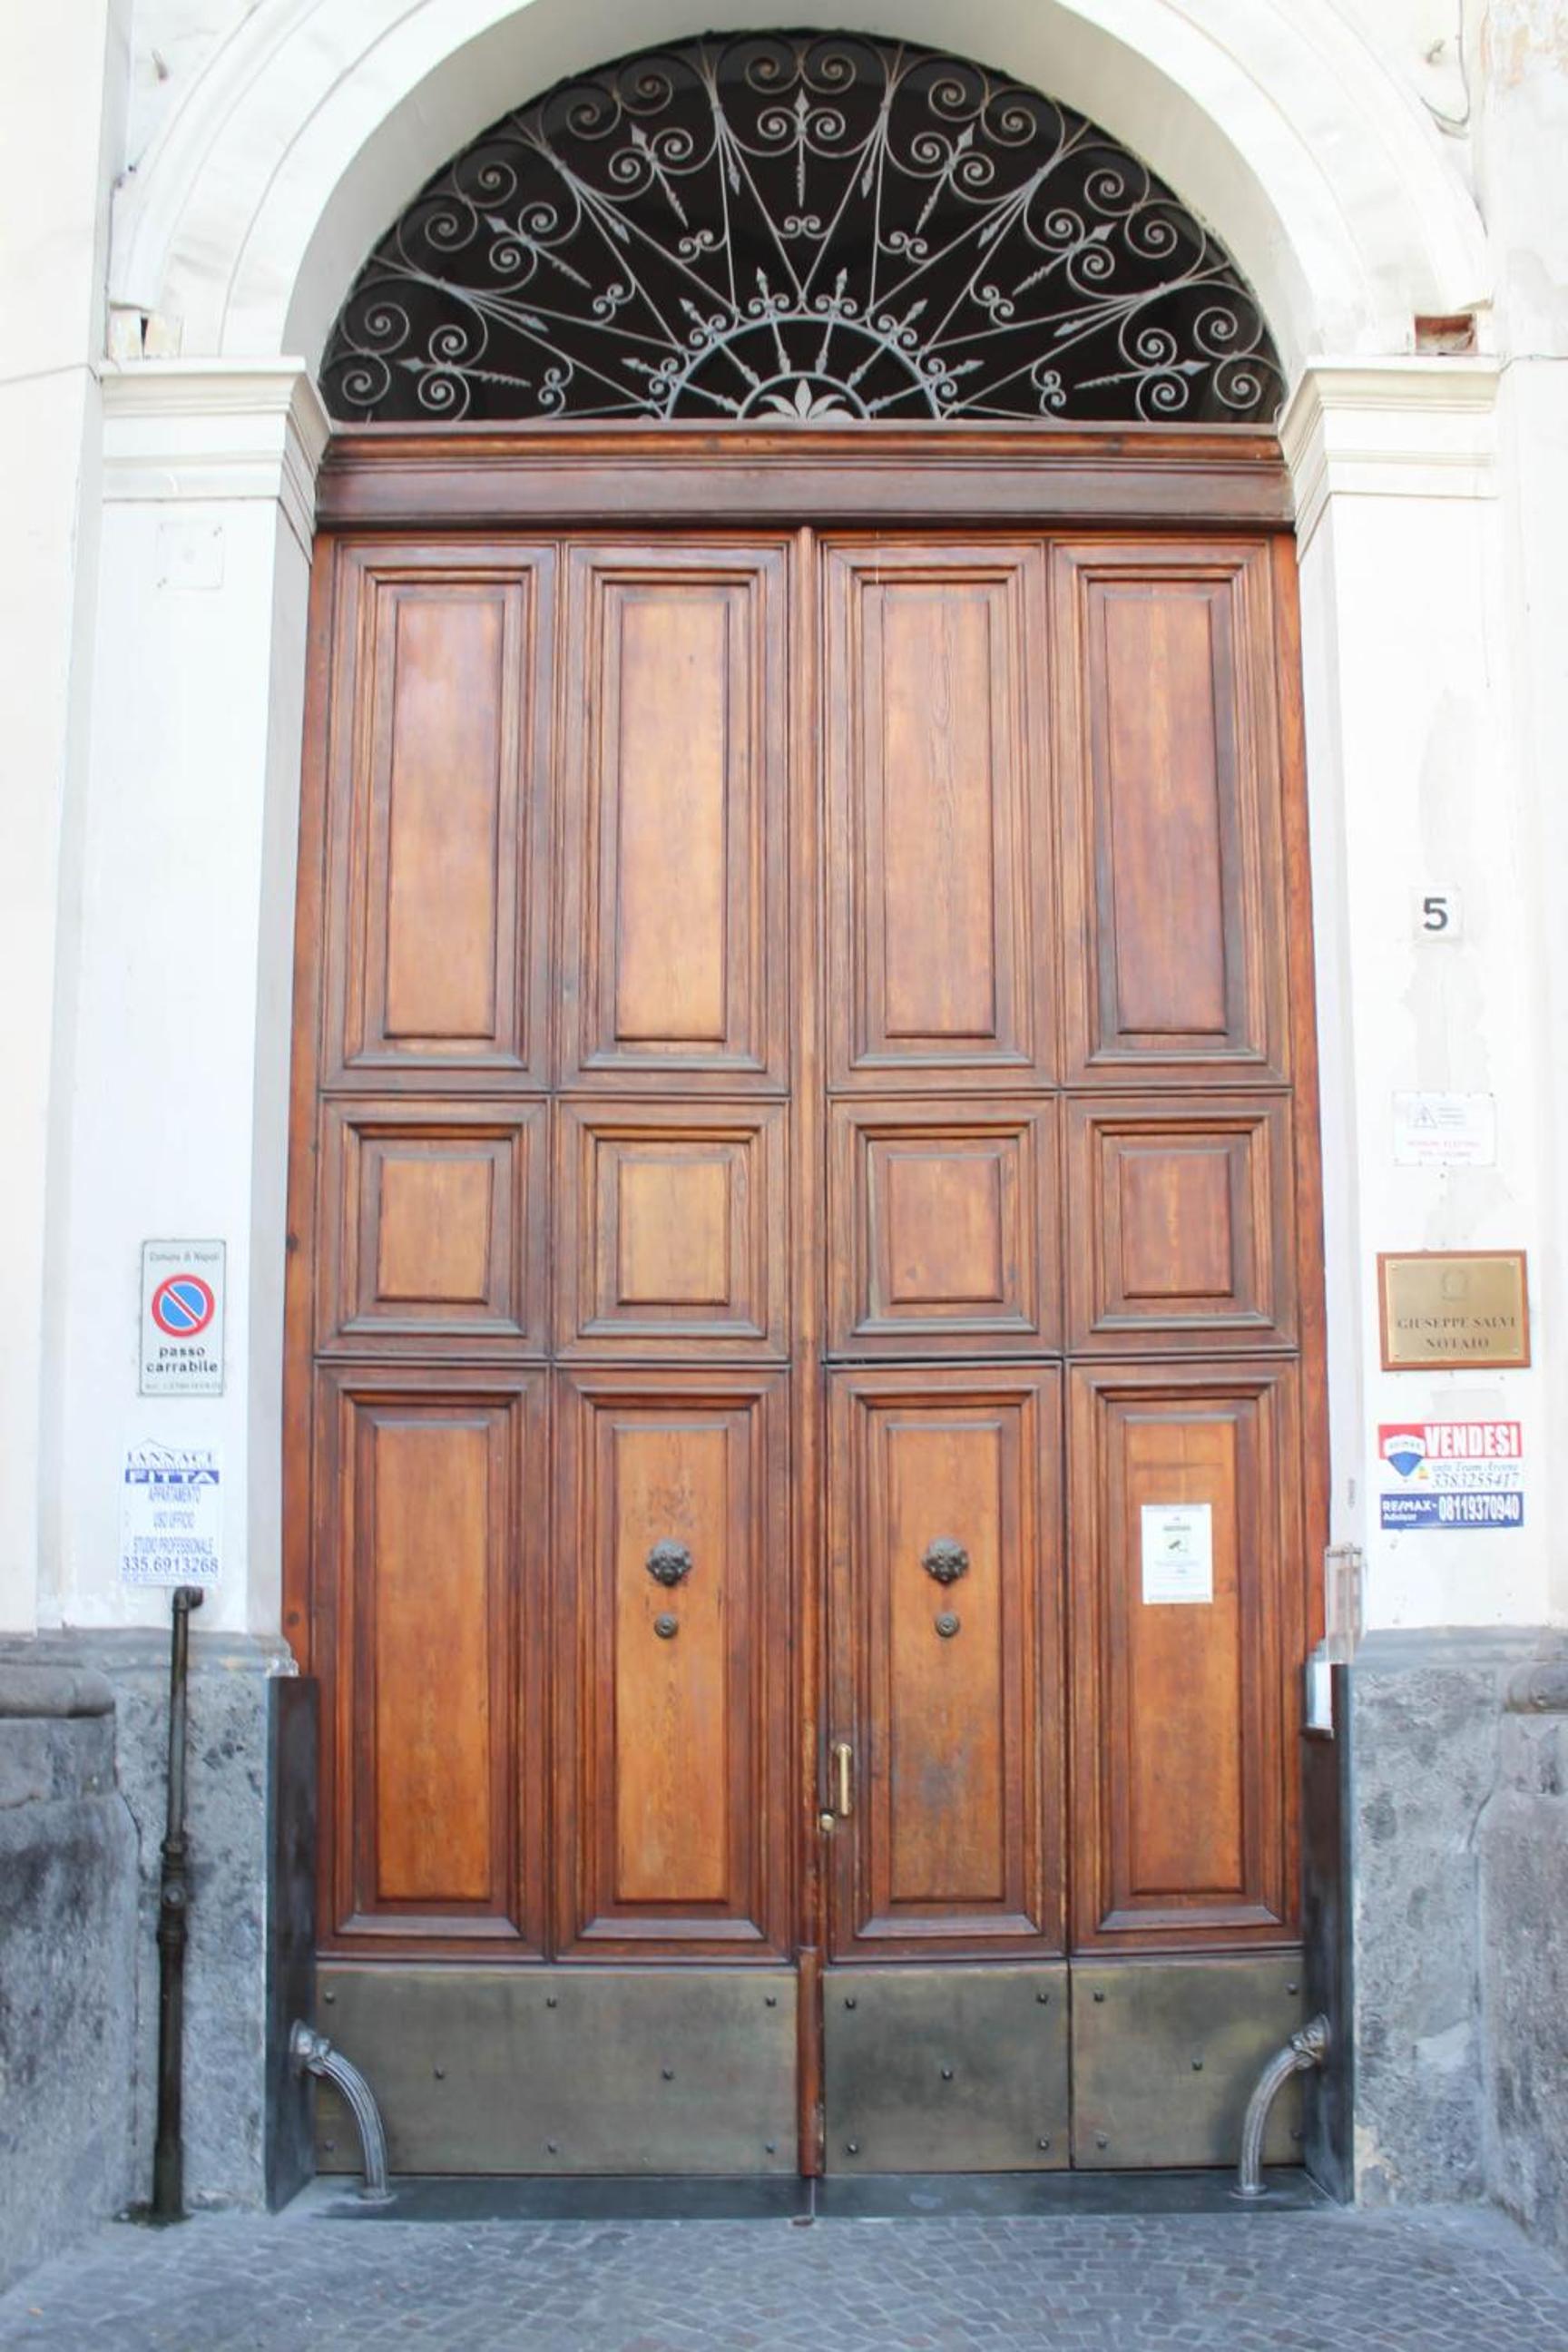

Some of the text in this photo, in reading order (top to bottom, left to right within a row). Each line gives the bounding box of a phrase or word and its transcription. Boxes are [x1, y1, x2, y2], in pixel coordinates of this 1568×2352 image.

[1424, 897, 1448, 931] 5
[1397, 1316, 1516, 1329] GIUSEPPE SALVI
[1426, 1337, 1490, 1349] NOTAIO
[159, 1347, 206, 1359] passo
[146, 1359, 218, 1373] carrabile
[1424, 1424, 1519, 1457] VENDESI
[129, 1469, 216, 1484] FITTA
[1437, 1494, 1521, 1522] 08119370940
[122, 1555, 219, 1573] 335.6913268
